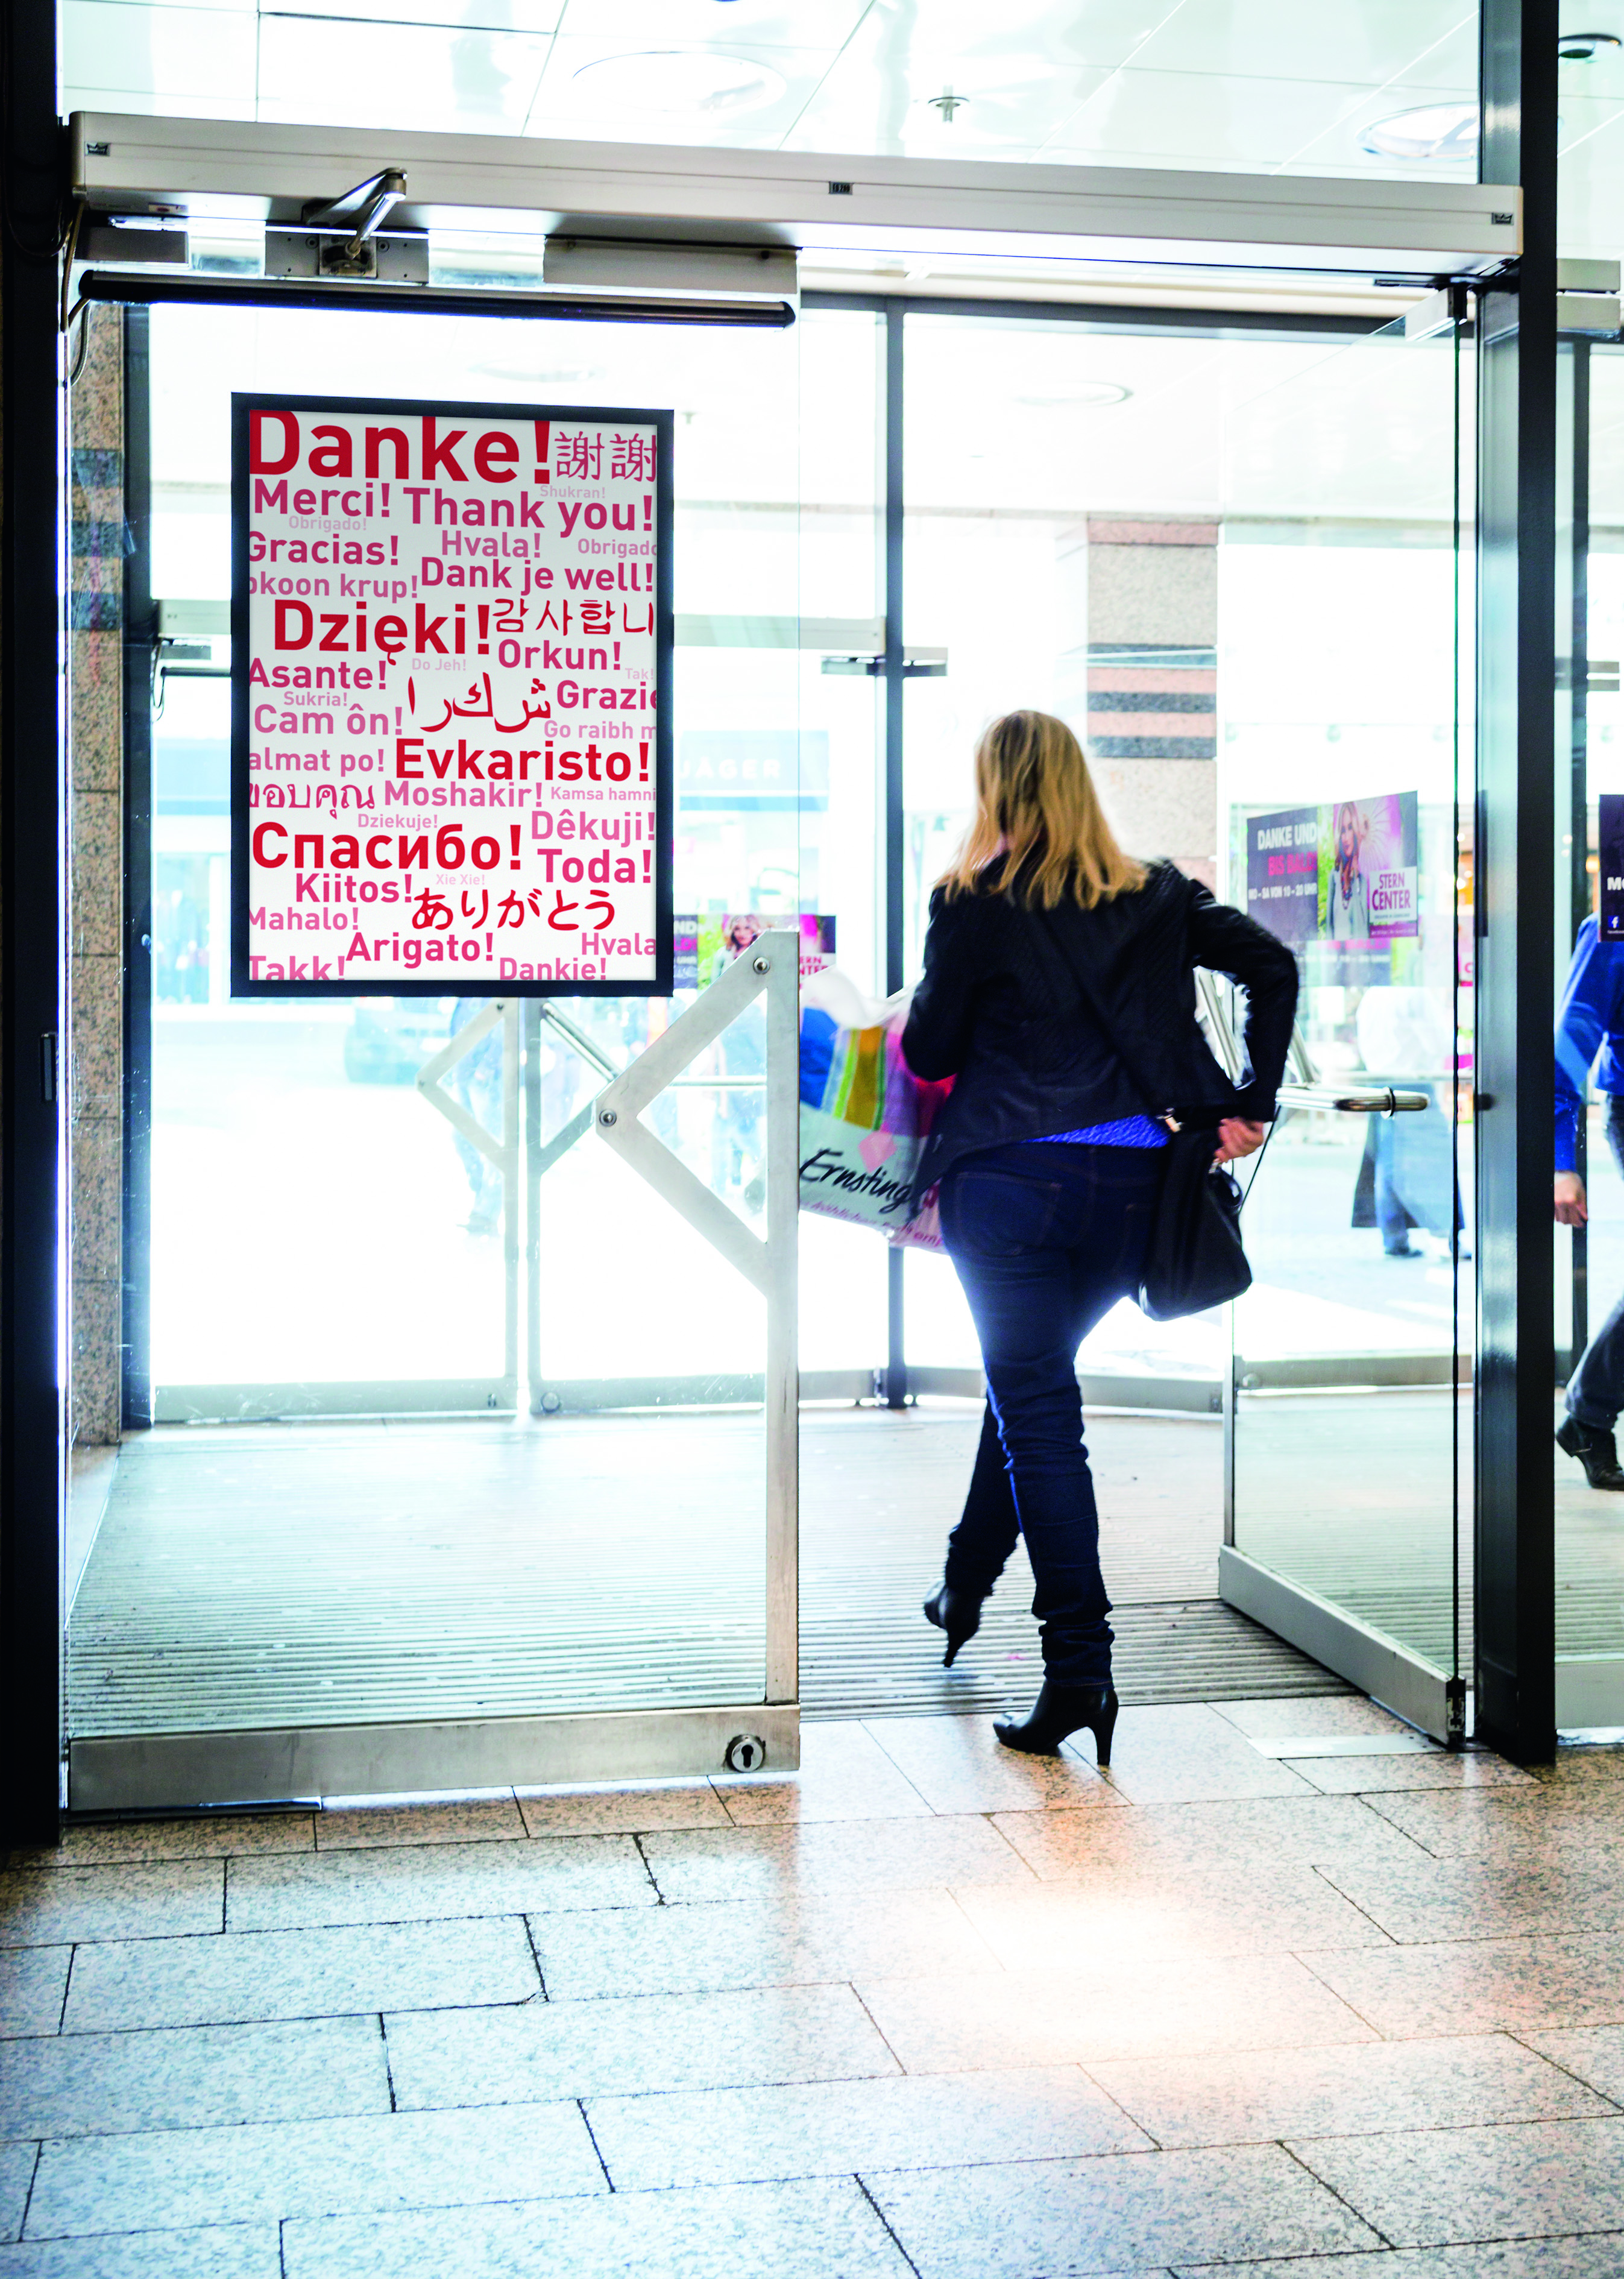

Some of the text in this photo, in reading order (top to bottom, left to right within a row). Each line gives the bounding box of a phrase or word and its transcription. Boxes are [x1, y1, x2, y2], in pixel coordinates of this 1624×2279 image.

[249, 410, 550, 484] Danke!
[555, 431, 656, 482] 謝謝
[255, 479, 389, 517] Merci!
[541, 486, 605, 497] Shukran!
[289, 516, 366, 532] Obrigado!
[403, 487, 652, 538] Thank you!
[250, 531, 398, 566] Gracias!
[442, 530, 540, 558] Hvala!
[341, 573, 417, 604] krup!
[422, 556, 652, 596] Dank je well!
[493, 598, 653, 636] 감사합니
[275, 599, 489, 666] Dzięki!
[412, 658, 465, 670] Do Jeh!
[499, 639, 620, 670] Orkun!
[250, 658, 386, 690] Asante!
[625, 668, 653, 679] Tak!
[284, 691, 347, 707] Sukria!
[408, 672, 551, 733] شكرا
[255, 704, 402, 735] Cam ôn!
[544, 720, 571, 738] Go
[579, 720, 634, 739] raibh
[341, 749, 383, 777] po!
[396, 738, 649, 781] Evkaristo!
[385, 780, 542, 807] Moshakir!
[551, 786, 656, 801] Kamsa hamni
[358, 813, 438, 831] Dziekuje!
[532, 809, 655, 848] Dêkuji!
[1257, 822, 1317, 850] DANKE UND
[252, 822, 521, 870] Спасибо!
[436, 874, 485, 885] Xie Xie!
[537, 848, 651, 883] Toda!
[1268, 854, 1285, 877] BIS
[1379, 872, 1405, 889] STERN
[296, 873, 412, 903] Kiitos!
[1372, 889, 1411, 911] CENTER
[250, 907, 358, 930] Mahalo!
[412, 887, 615, 931] ありがとう
[345, 932, 493, 969] Arigato!
[500, 957, 606, 980] Dankie!
